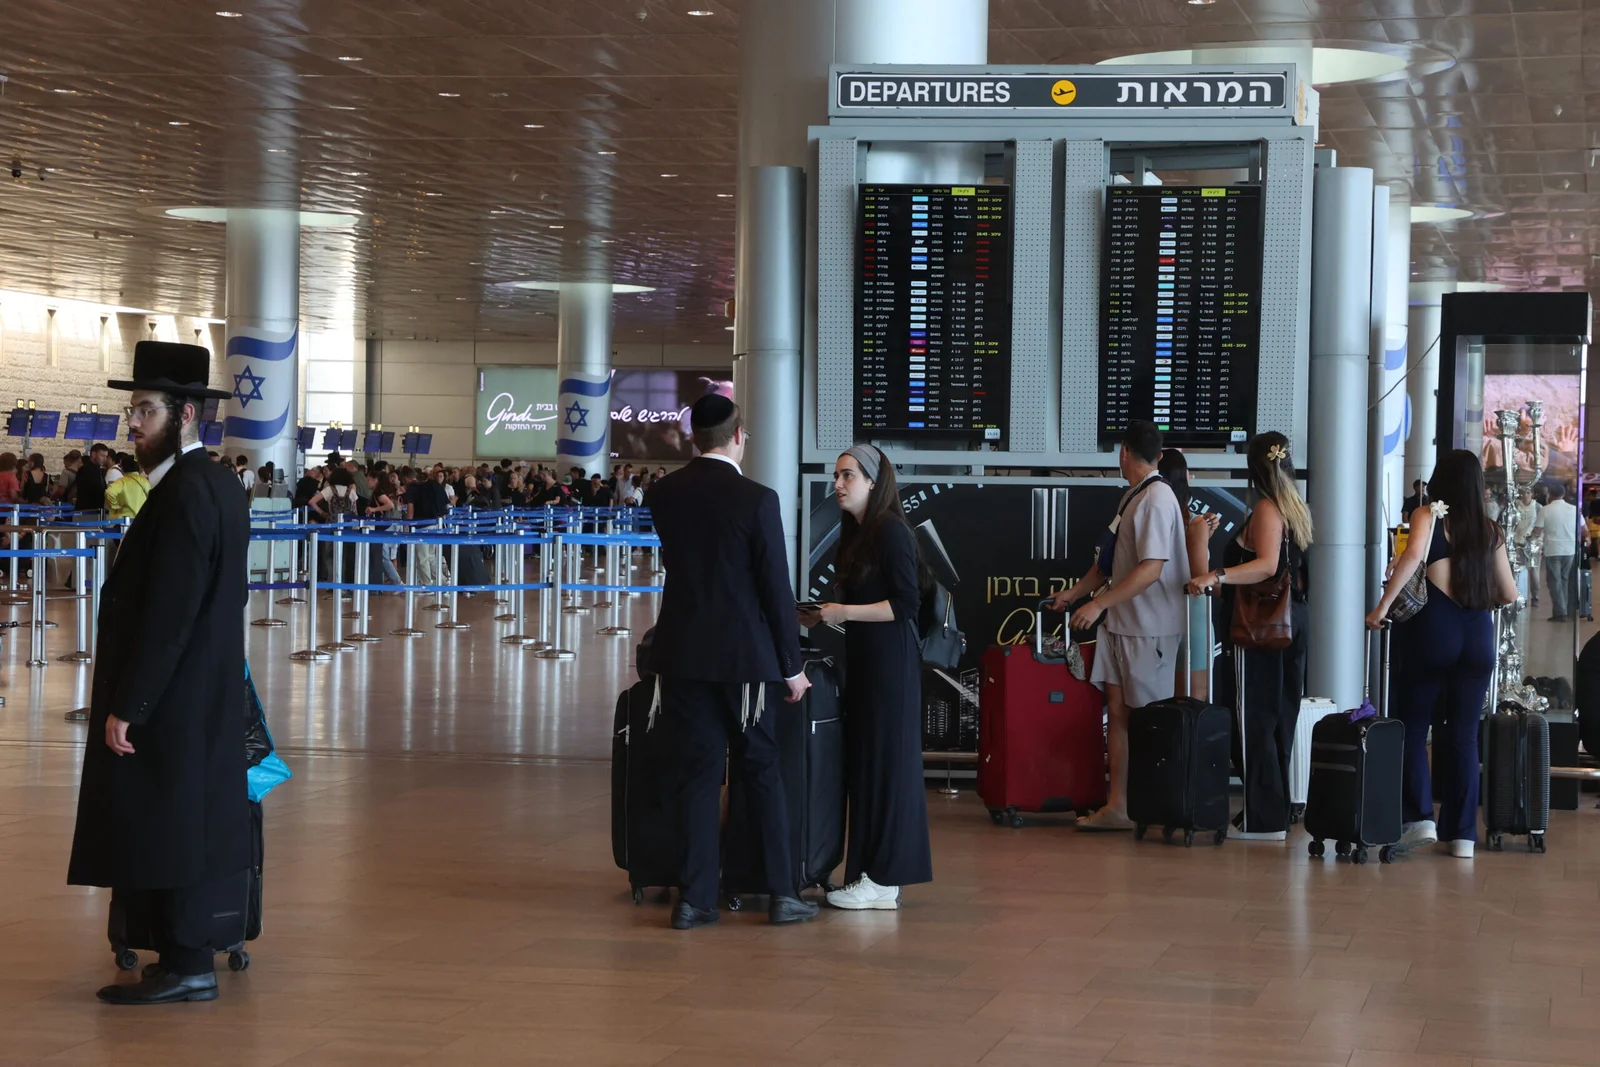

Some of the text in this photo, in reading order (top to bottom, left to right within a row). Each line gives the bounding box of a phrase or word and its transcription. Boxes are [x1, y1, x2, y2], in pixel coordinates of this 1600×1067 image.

[849, 81, 1010, 104] DEPARTURES
[1117, 80, 1272, 104] המראות
[485, 392, 558, 435] Gindi
[637, 406, 690, 423] להרגיש
[902, 494, 920, 514] 55
[986, 576, 1041, 604] בזמן
